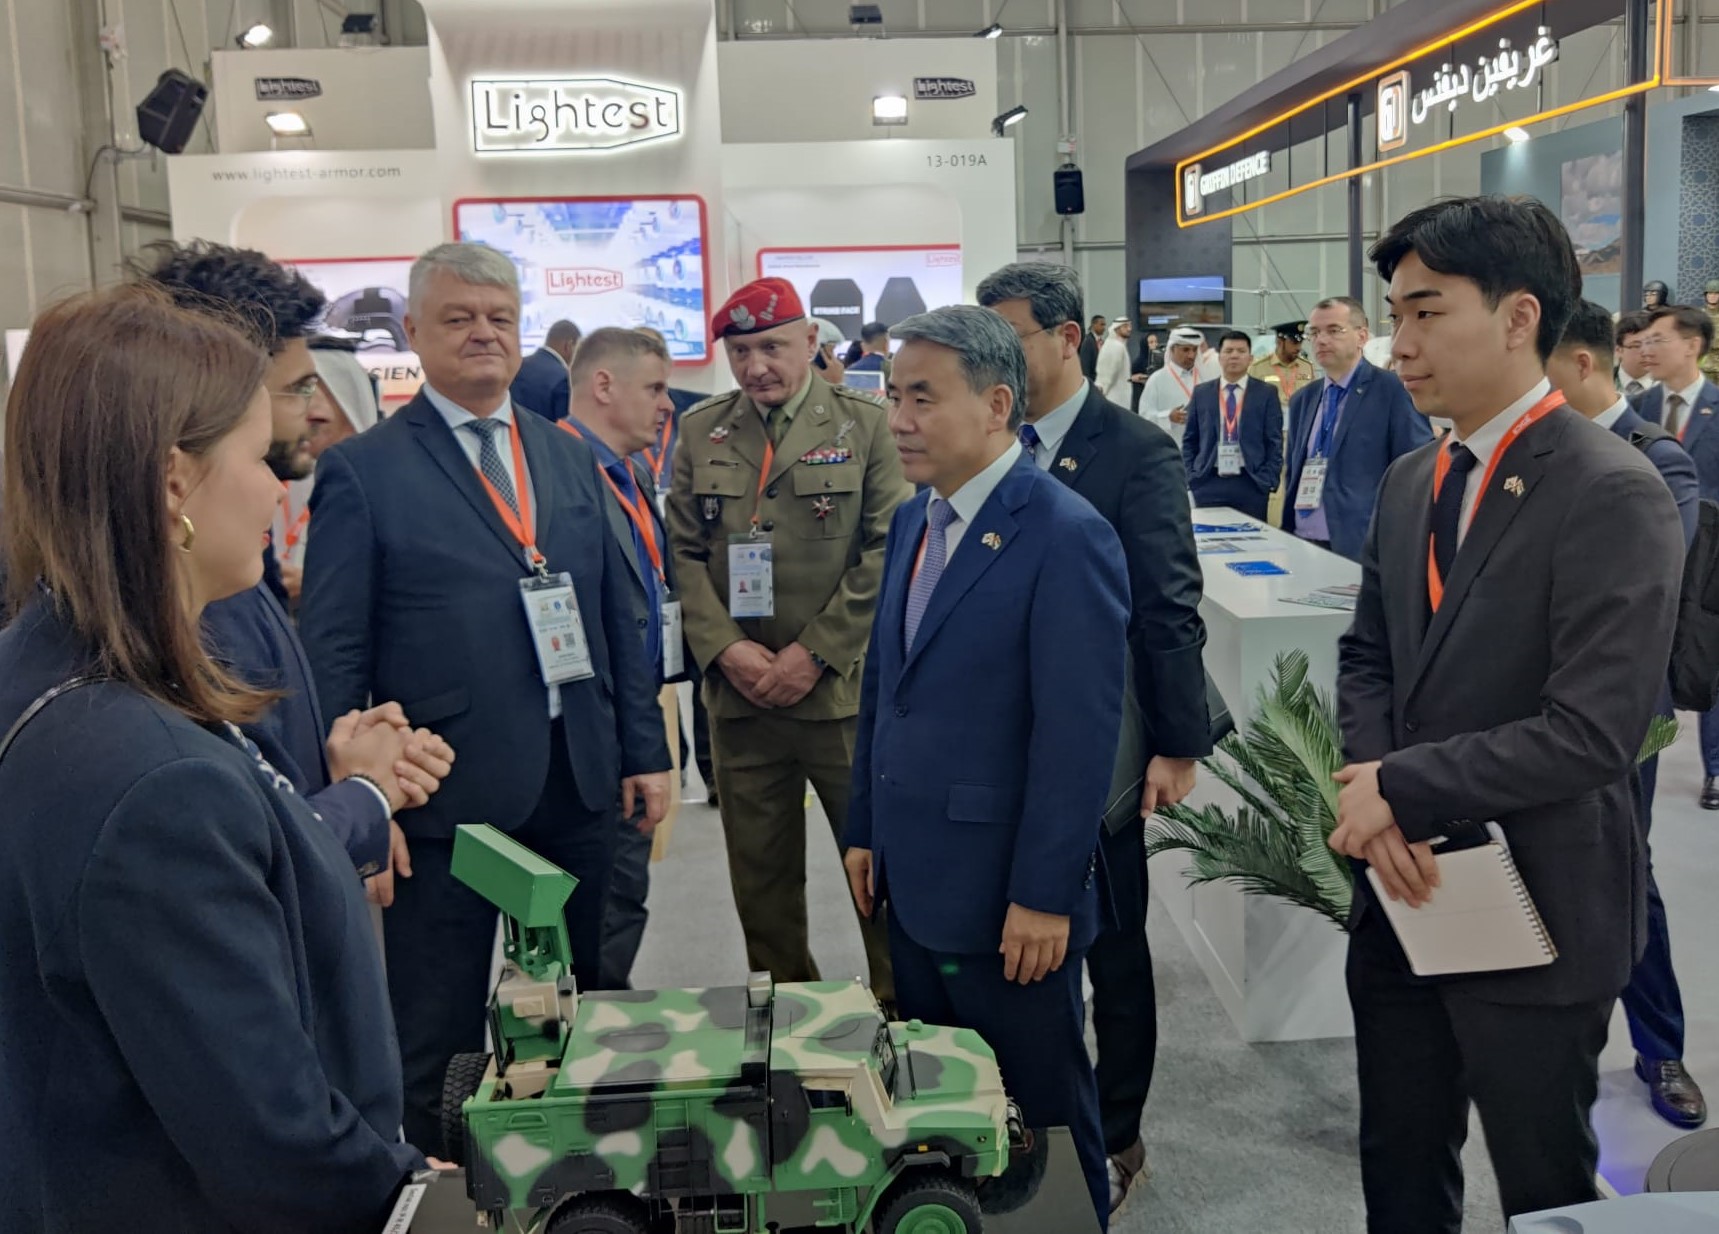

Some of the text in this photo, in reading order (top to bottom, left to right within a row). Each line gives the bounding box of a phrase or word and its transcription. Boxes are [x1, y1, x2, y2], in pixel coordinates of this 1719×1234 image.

[1411, 25, 1558, 124] غريفين ديفنس
[917, 79, 974, 95] Lightest
[485, 89, 668, 142] Lightest
[926, 153, 988, 168] 13-019A
[211, 165, 402, 187] www.lightest-armor.com
[549, 271, 619, 292] Lightest
